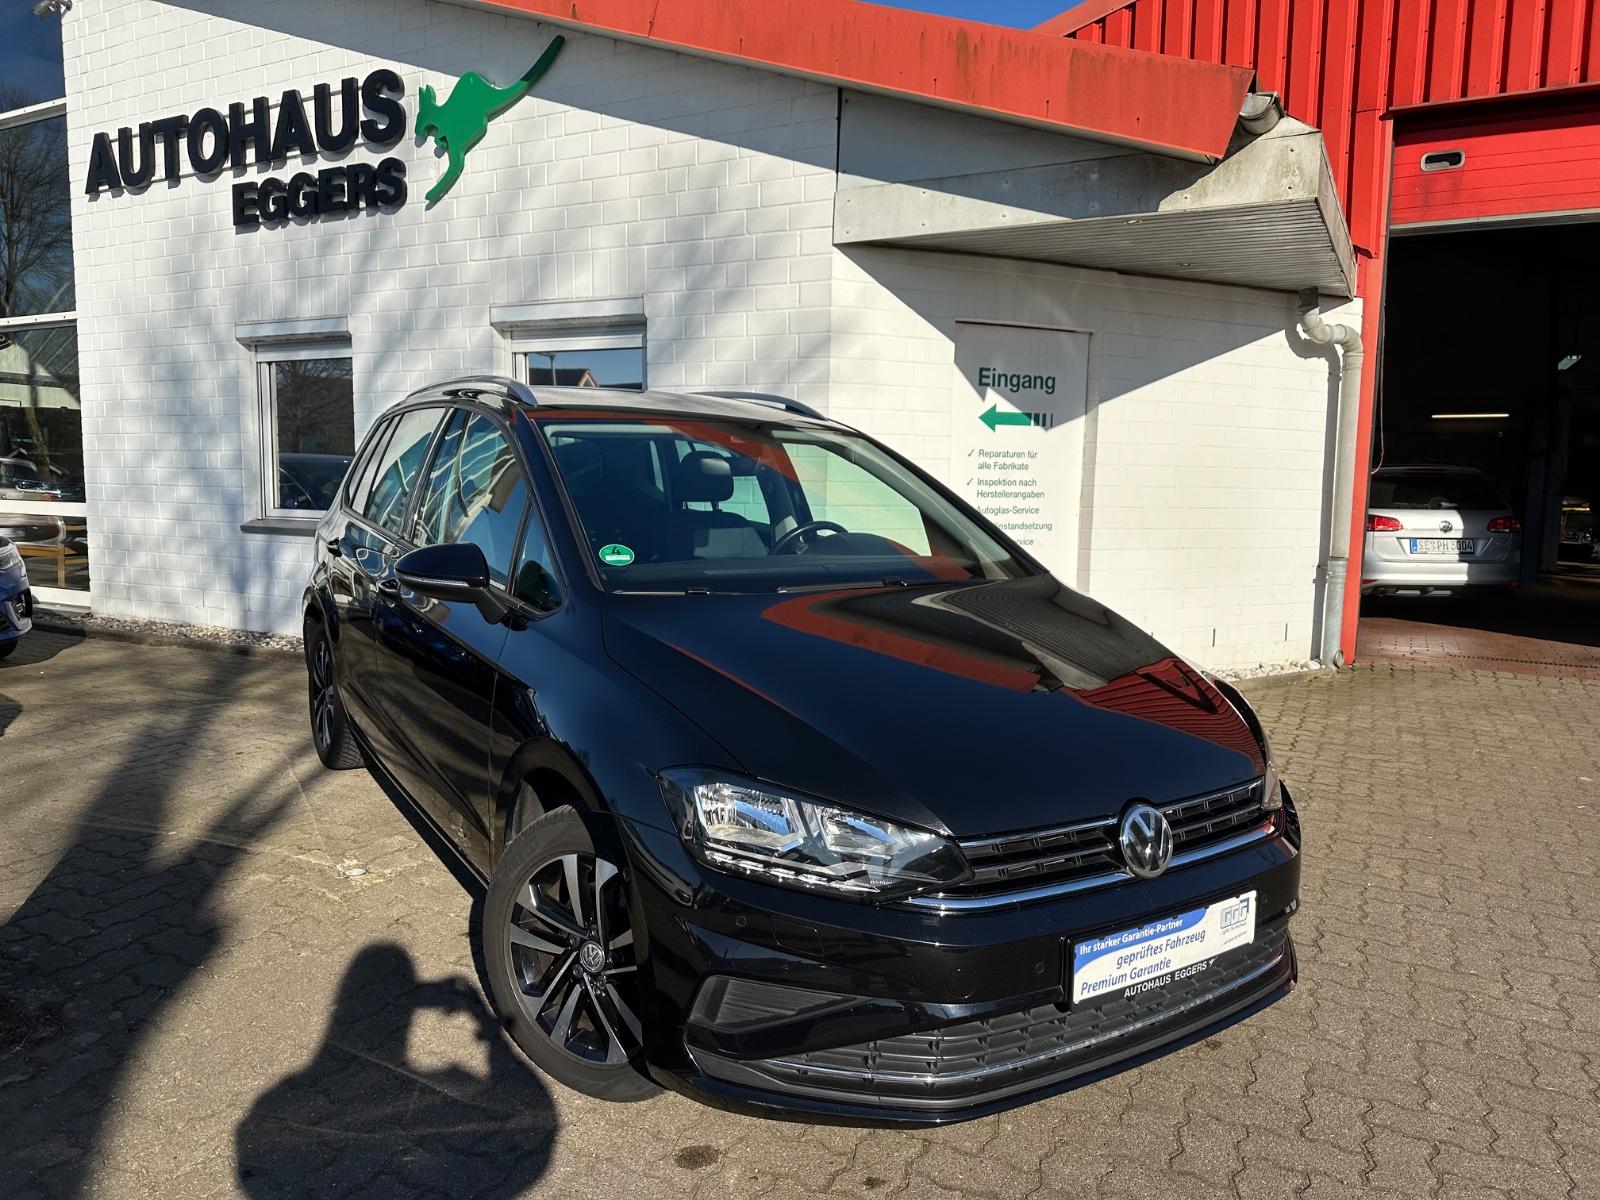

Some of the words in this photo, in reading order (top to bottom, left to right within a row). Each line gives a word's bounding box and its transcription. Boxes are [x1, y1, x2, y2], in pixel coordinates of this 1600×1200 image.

[85, 69, 407, 196] AUTOHAUS
[232, 157, 408, 227] EGGERS
[978, 367, 1056, 394] Eingang
[978, 449, 1026, 459] Reparaturen
[1027, 450, 1038, 459] für
[978, 462, 992, 470] alle
[993, 462, 1029, 470] Fabrikate
[976, 490, 1045, 500] Herstellerangaben
[977, 477, 1017, 488] Inspektion
[1019, 478, 1037, 487] nach
[976, 506, 1040, 516] Autoglas-Service
[611, 546, 621, 555] 4
[1079, 944, 1092, 956] Ihr
[1092, 937, 1122, 952] starker
[1121, 918, 1184, 944] Garantie-Partner
[1116, 943, 1164, 970] geprüftes
[1163, 929, 1207, 951] Fahrzeug
[1080, 973, 1128, 996] Premium
[1129, 957, 1172, 981] Garantie
[1123, 974, 1172, 998] AUTOHAUS
[1174, 960, 1208, 981] EGGERS
